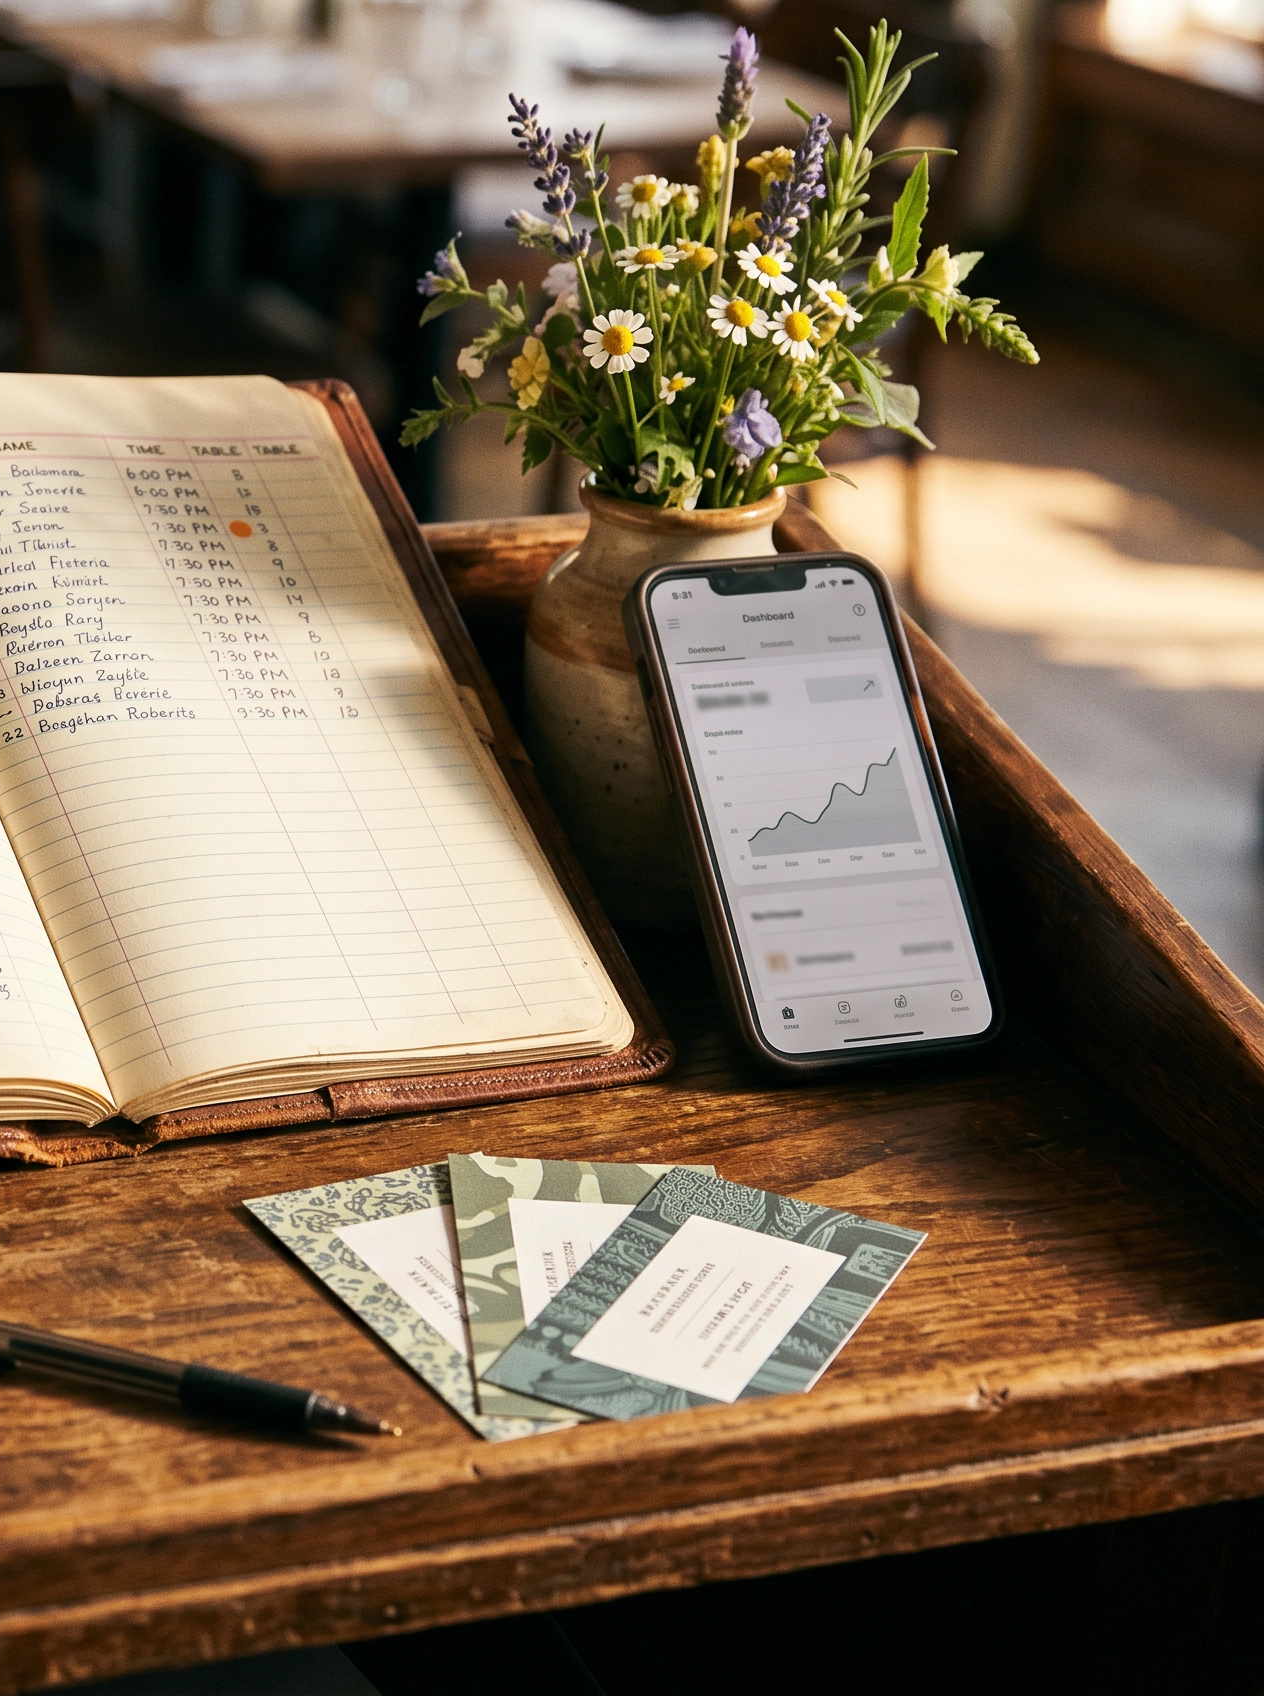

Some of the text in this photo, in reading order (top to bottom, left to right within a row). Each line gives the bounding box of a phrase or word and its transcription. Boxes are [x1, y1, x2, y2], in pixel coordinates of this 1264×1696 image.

[126, 445, 164, 455] TIME
[192, 446, 241, 456] TABLE
[253, 444, 300, 455] TABLE
[165, 468, 192, 481] PM
[174, 487, 200, 499] PM
[184, 504, 210, 516] PM
[192, 523, 218, 534] PM
[199, 540, 225, 551] PM
[208, 559, 234, 570] PM
[218, 577, 242, 588] PM
[279, 577, 296, 588] 10
[184, 595, 252, 606] 7:30 PM
[66, 613, 103, 630] Rary
[193, 613, 261, 624] 7:30 PM
[742, 611, 794, 623] Dashboard
[203, 632, 269, 643] 7:30 PM
[211, 650, 278, 662] 7:30 PM
[219, 669, 288, 680] 7:30 PM
[228, 688, 295, 699] 7:30 PM
[282, 706, 308, 718] PM
[2, 728, 23, 743] 22
